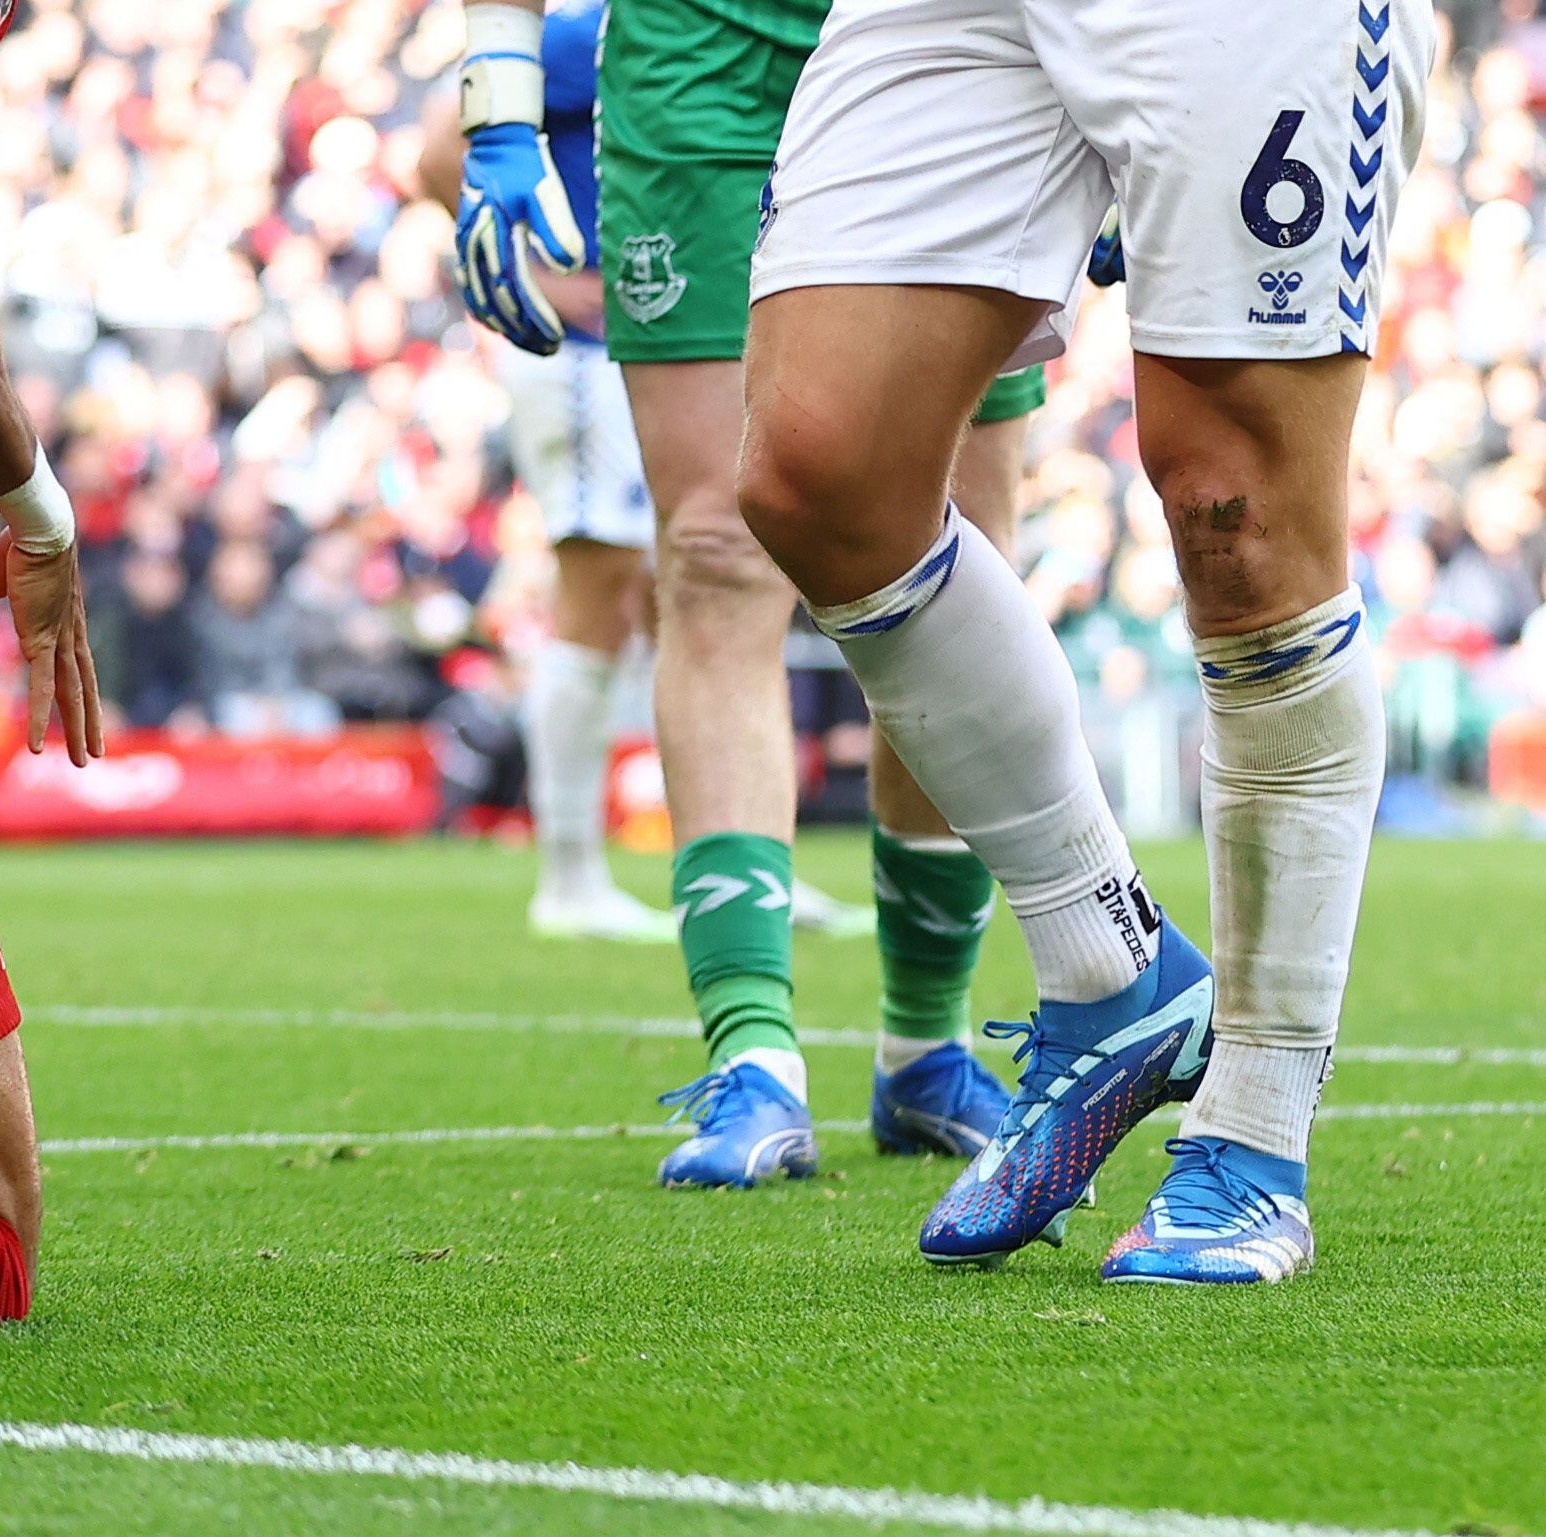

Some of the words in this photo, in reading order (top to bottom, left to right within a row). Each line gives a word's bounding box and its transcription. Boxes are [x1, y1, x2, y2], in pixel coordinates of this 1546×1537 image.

[1240, 110, 1324, 249] 6
[1248, 307, 1307, 324] hummel
[1105, 894, 1151, 973] TAPEDES
[1081, 1068, 1128, 1111] PREDATOR
